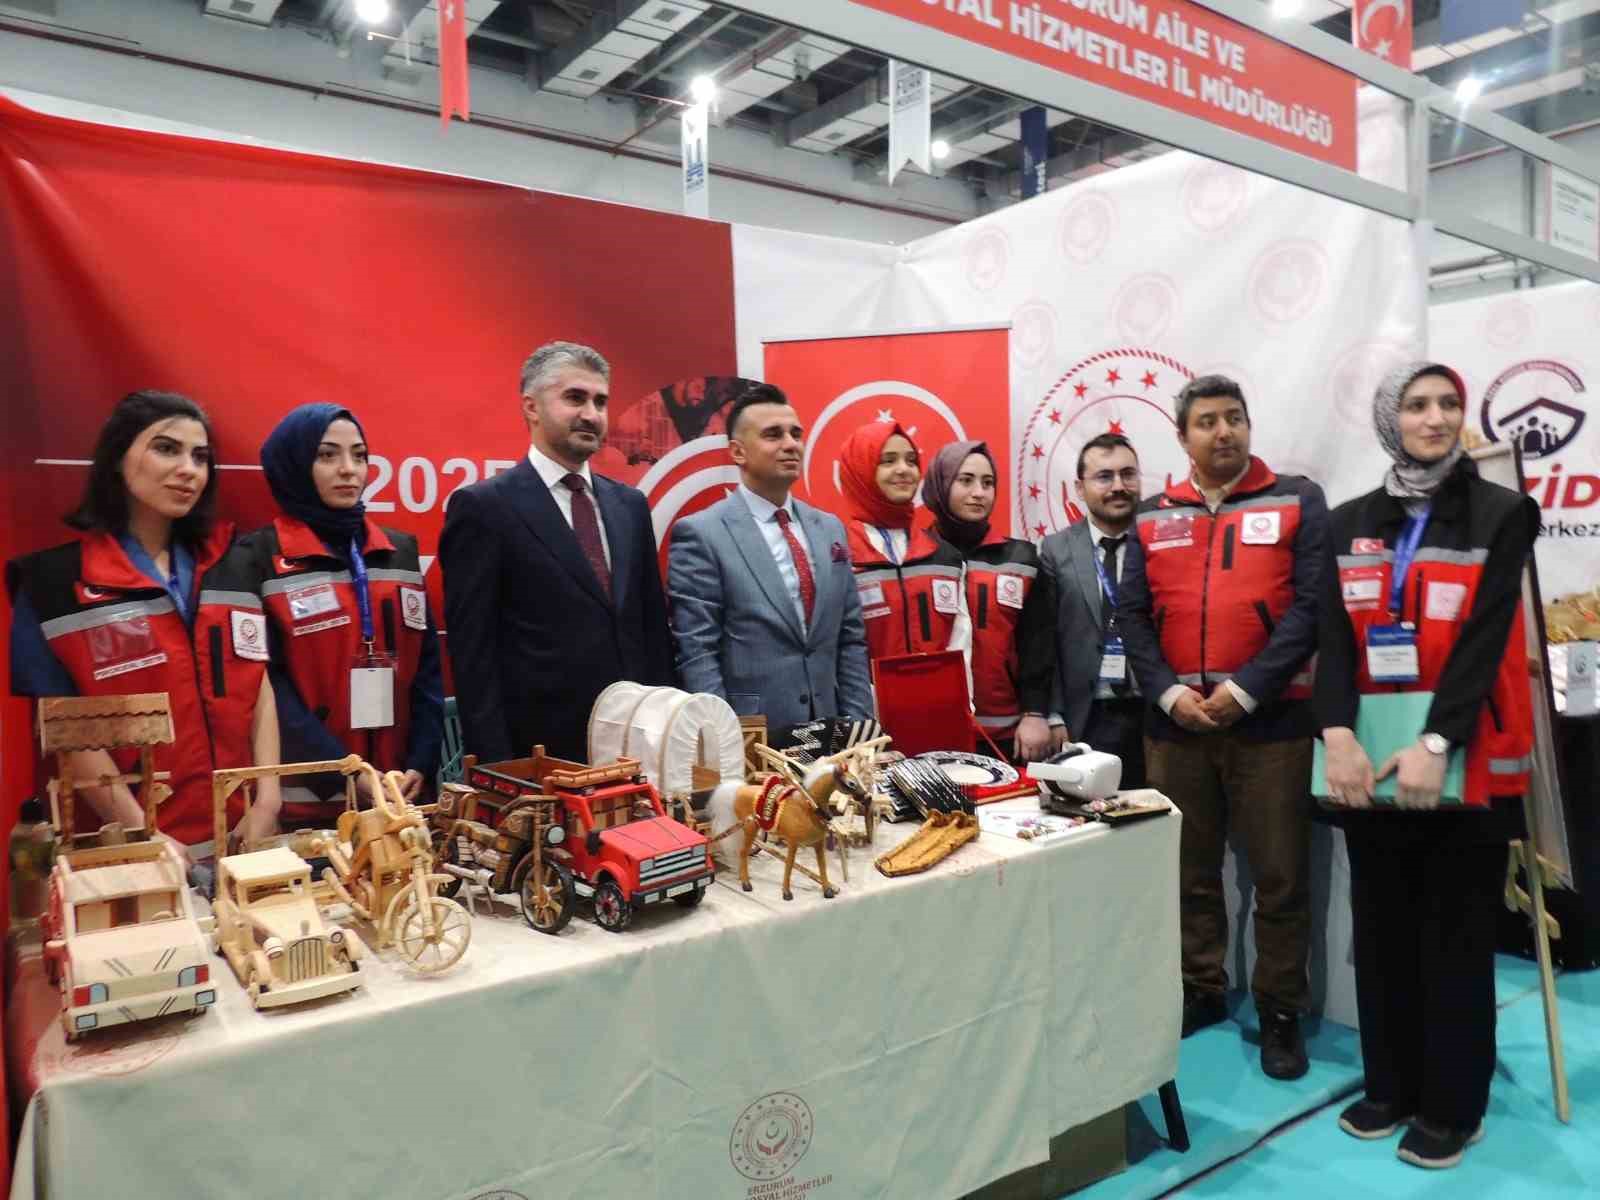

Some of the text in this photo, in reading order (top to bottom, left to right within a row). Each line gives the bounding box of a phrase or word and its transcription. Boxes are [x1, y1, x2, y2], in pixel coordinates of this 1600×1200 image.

[1009, 2, 1169, 88] HİZMETLER
[1173, 57, 1196, 99] İL
[1201, 75, 1334, 147] MÜDÜRLÜĞÜ
[1154, 11, 1210, 60] AİLE
[1214, 35, 1246, 73] VE
